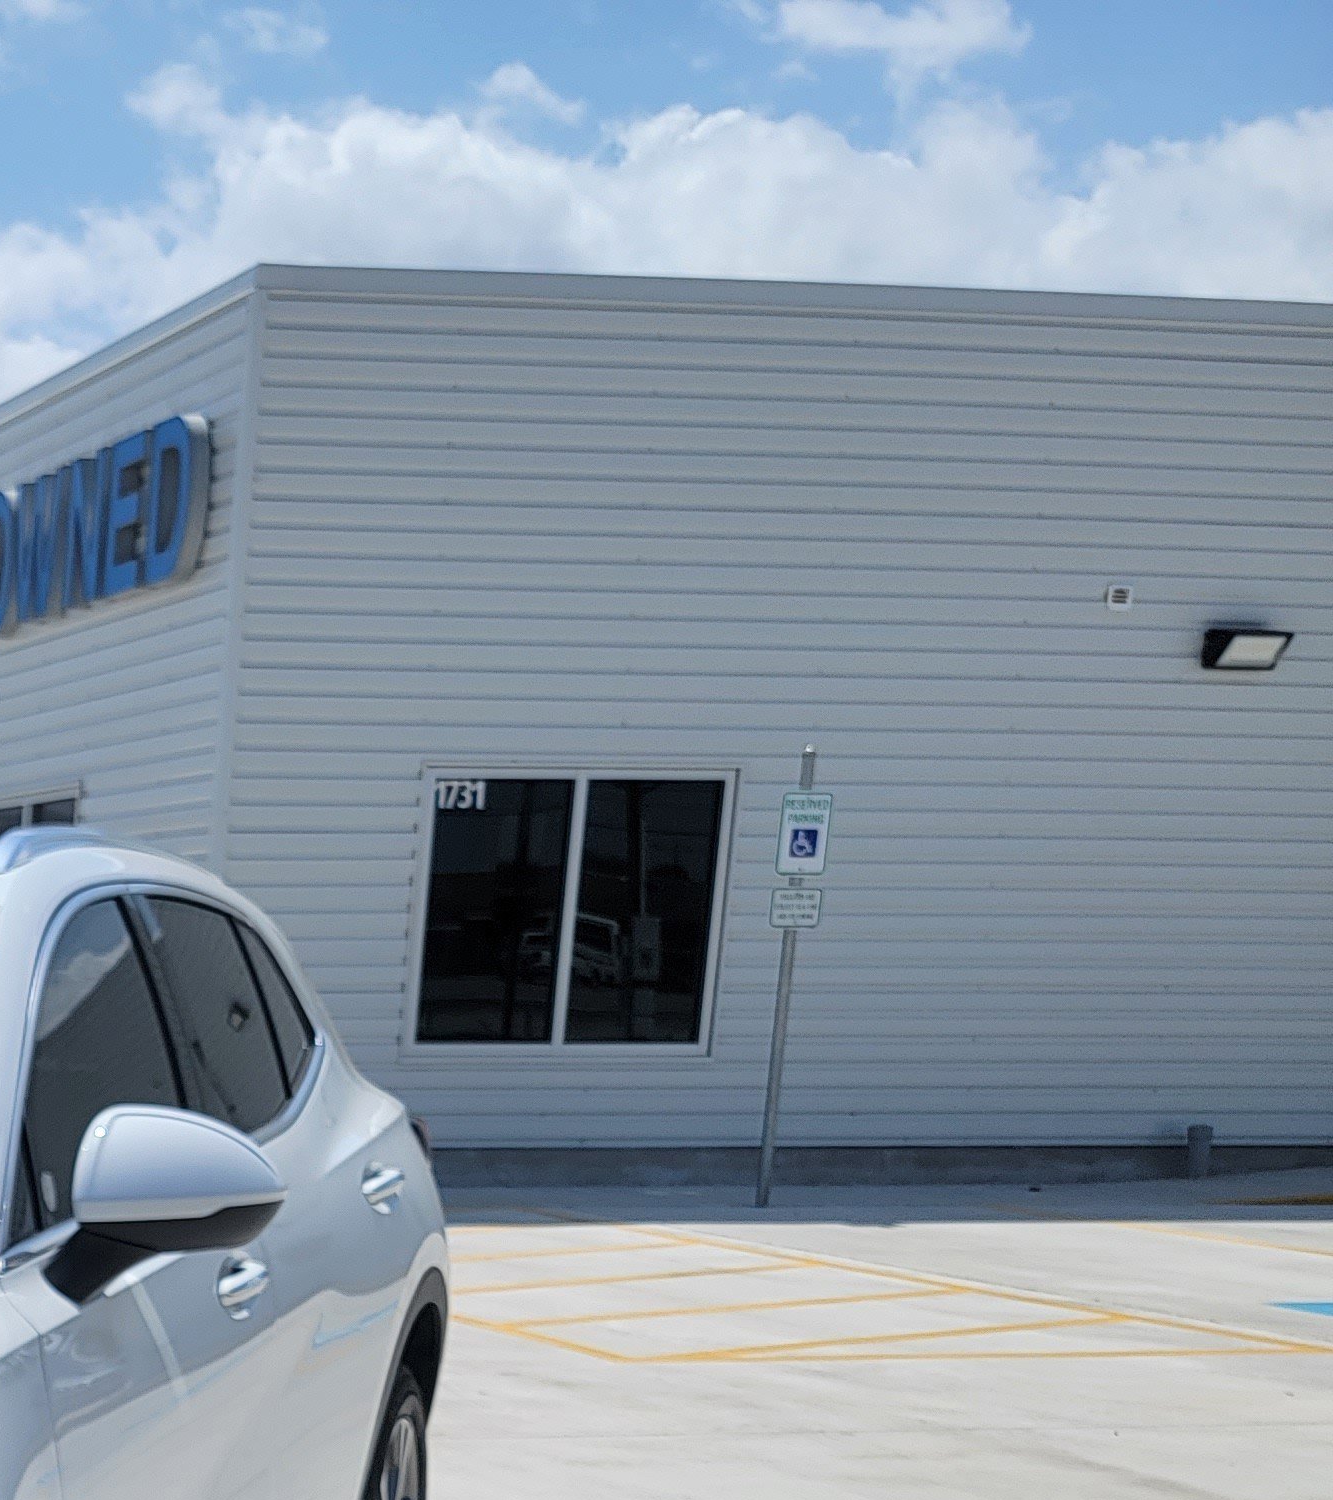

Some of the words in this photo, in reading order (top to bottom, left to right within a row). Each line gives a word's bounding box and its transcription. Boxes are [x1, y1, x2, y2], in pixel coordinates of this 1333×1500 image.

[436, 780, 486, 810] 1731
[785, 799, 830, 811] RESERVED
[787, 813, 825, 825] PARKING
